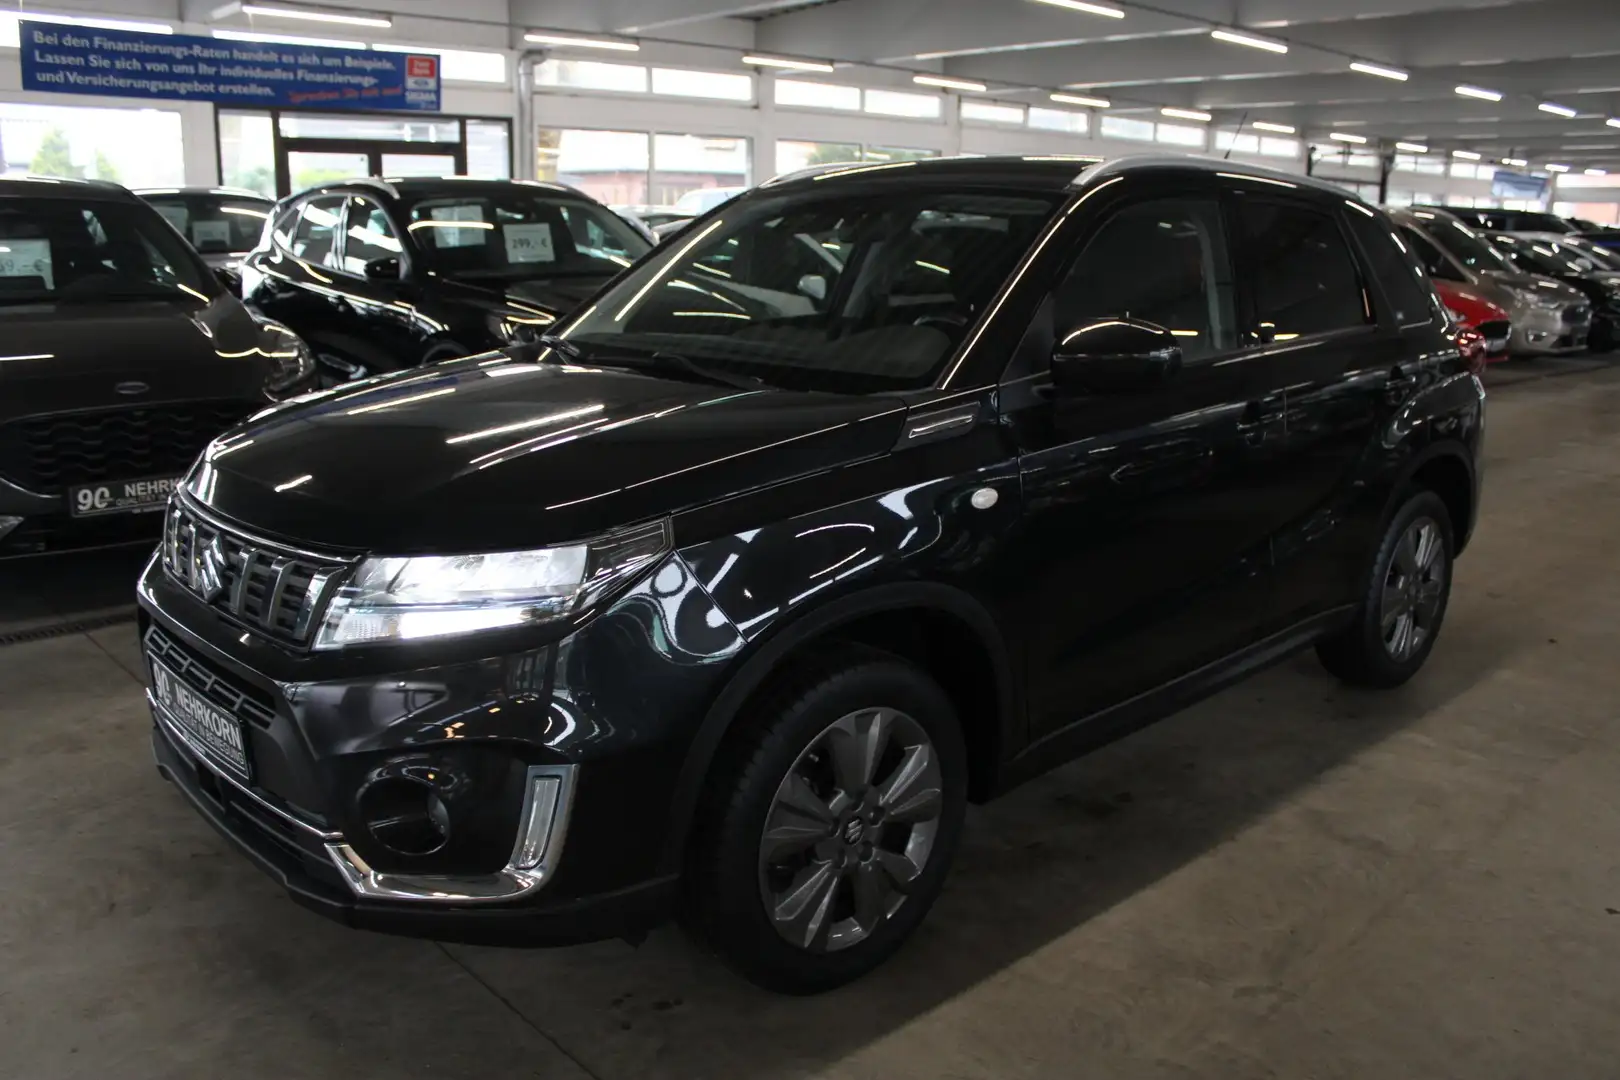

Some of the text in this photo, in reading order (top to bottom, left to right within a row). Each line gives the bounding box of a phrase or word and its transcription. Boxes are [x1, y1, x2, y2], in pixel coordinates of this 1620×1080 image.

[33, 30, 58, 44] Bei
[63, 33, 90, 48] den
[94, 36, 229, 60] Finanzierungs-Raten
[233, 48, 278, 63] handelt
[281, 54, 295, 64] es
[298, 52, 320, 65] sich
[323, 56, 343, 67] um
[35, 50, 379, 87] Lassen Sie sich von uns Ihr individuelles Finanzierungs-
[36, 70, 275, 96] und Versicherungsangebot erstellen.
[174, 683, 242, 751] NEHRKORN
